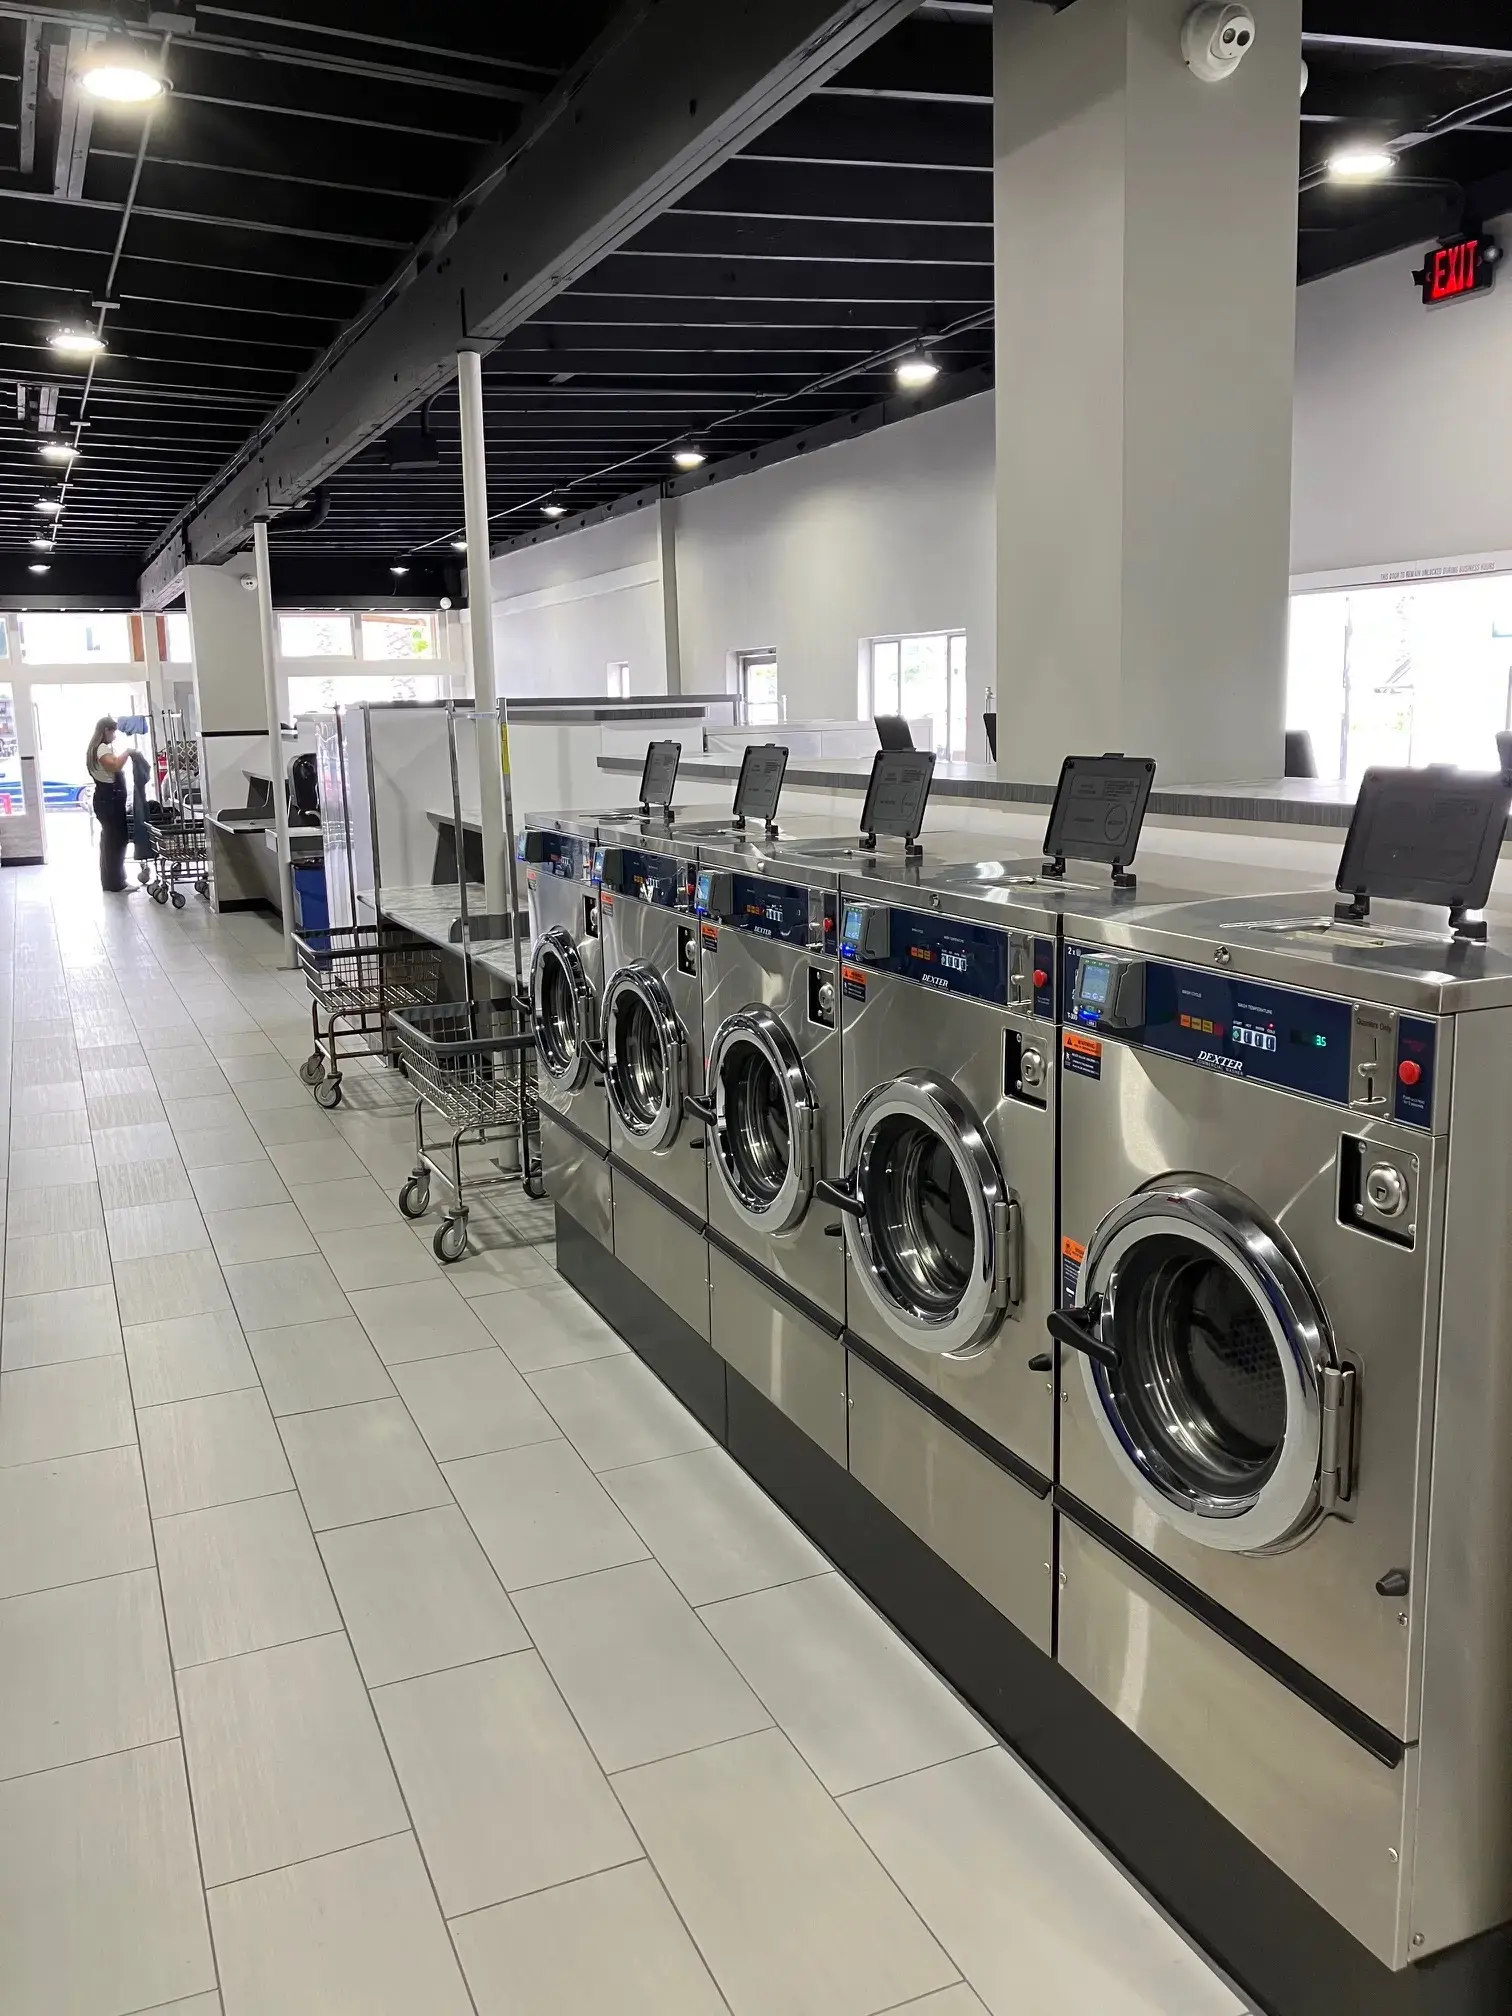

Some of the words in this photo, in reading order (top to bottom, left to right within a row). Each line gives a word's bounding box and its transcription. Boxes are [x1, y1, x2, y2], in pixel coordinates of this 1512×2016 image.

[1432, 240, 1479, 300] EXIT
[1380, 573, 1389, 581] THIS
[1389, 572, 1400, 580] DOOR
[1422, 567, 1442, 577] UNLOCKED
[1442, 566, 1458, 575] DURING
[1459, 564, 1480, 573] BUSINESS
[1480, 561, 1496, 571] HOURS
[1067, 946, 1072, 955] 2
[921, 973, 949, 988] DEXTER
[1379, 1022, 1392, 1033] Only
[1197, 1050, 1243, 1071] DEXTER
